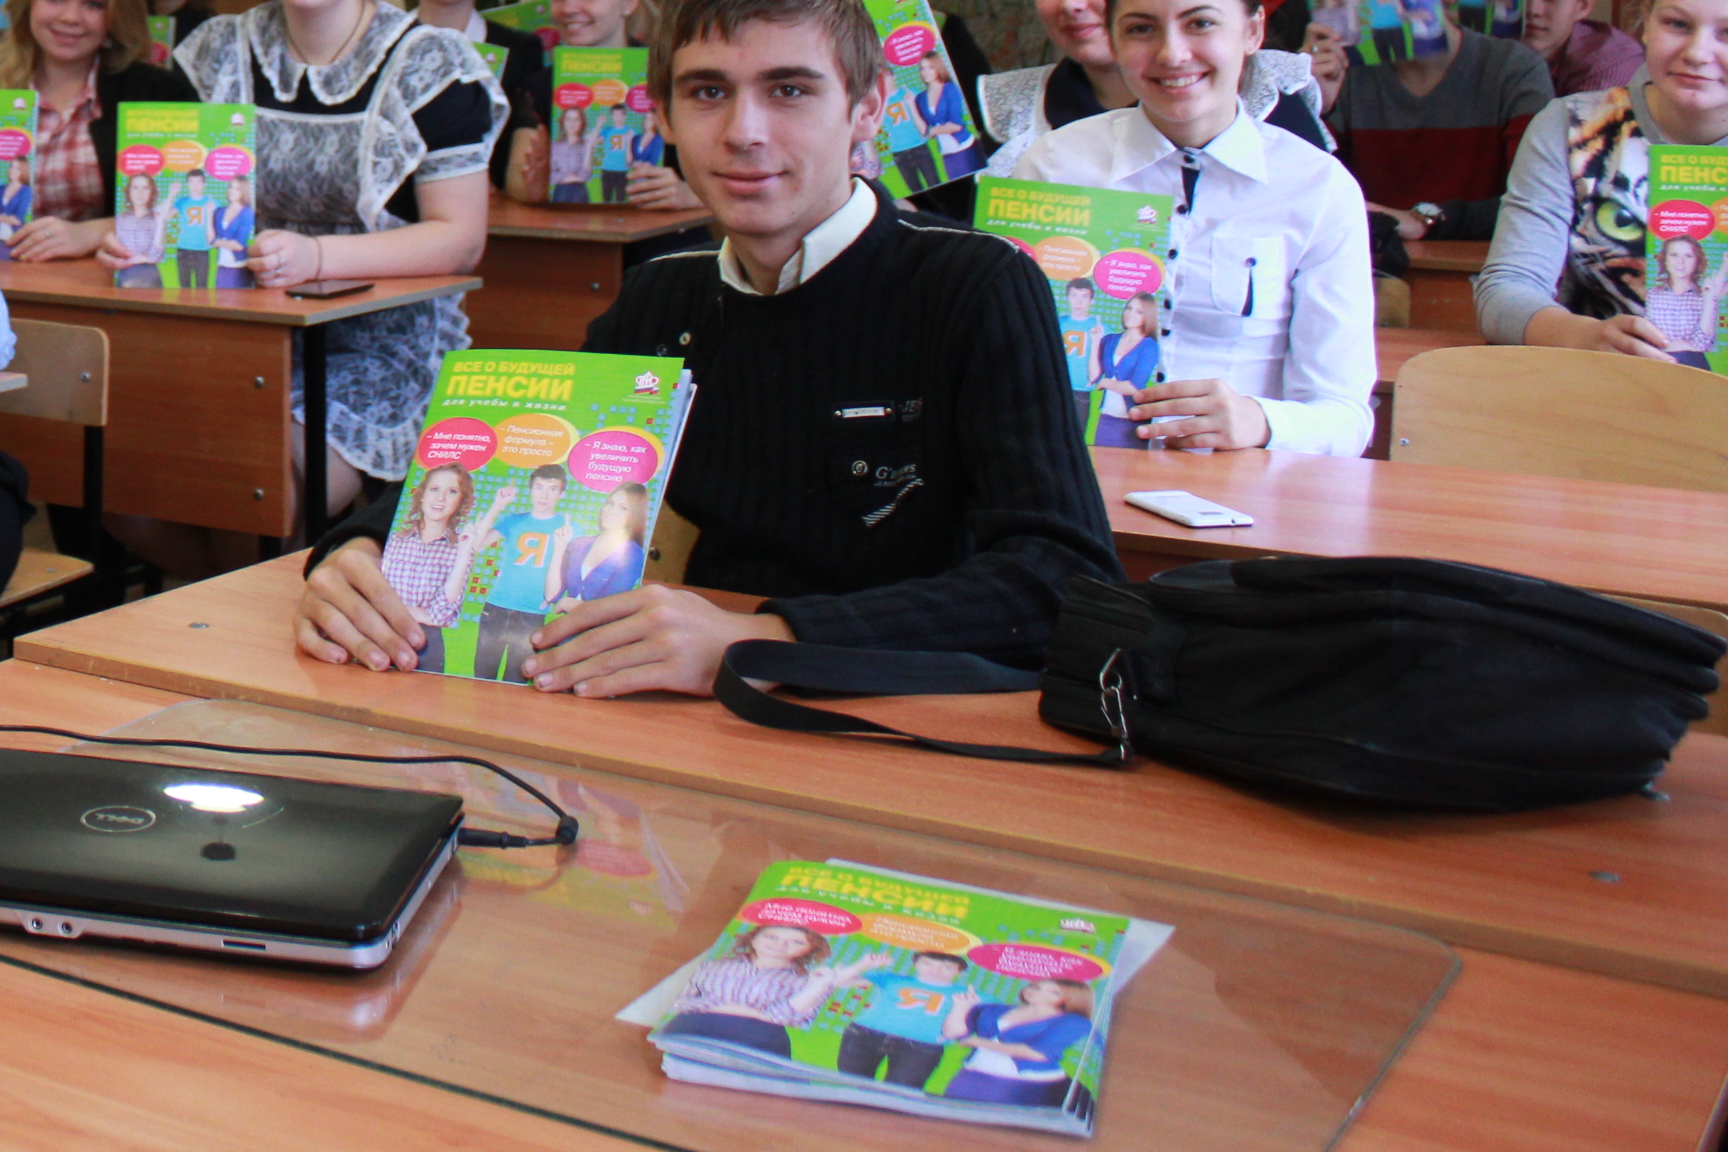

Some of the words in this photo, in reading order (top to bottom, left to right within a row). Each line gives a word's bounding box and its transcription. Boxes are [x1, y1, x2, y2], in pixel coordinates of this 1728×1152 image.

[1660, 154, 1686, 164] ВСЕ
[1688, 154, 1698, 164] О
[1660, 165, 1728, 184] ПЕНС
[990, 187, 1016, 199] ВСЕ
[1016, 189, 1027, 200] О
[1029, 190, 1092, 206] БУДУЩЕЙ
[987, 199, 1092, 227] ПЕНСИИ
[1063, 330, 1087, 358] Я
[453, 361, 483, 373] ВСЕ
[485, 361, 497, 373] О
[499, 361, 576, 376] БУДУЩЕЙ
[446, 375, 574, 401] ПЕНСИИ
[442, 399, 466, 407] для
[468, 398, 508, 407] учебы
[512, 400, 520, 408] и
[524, 402, 567, 411] жизни
[433, 432, 452, 440] Мне
[453, 434, 491, 443] понятно,
[507, 425, 564, 437] Пенсионная
[429, 442, 458, 450] зачем
[458, 443, 487, 452] нужен
[504, 435, 547, 446] формула
[519, 447, 553, 457] просто
[593, 441, 601, 449] Я
[602, 443, 628, 453] знаю,
[630, 446, 648, 454] как
[427, 451, 462, 460] СНИЛС
[589, 453, 639, 464] увеличить
[588, 461, 632, 473] будущую
[585, 472, 623, 483] пенсию
[515, 532, 550, 568] Я
[95, 813, 145, 825] DELL
[789, 867, 833, 879] ВСЕ
[837, 871, 854, 882] О
[858, 876, 970, 906] БУДУЩЕЙ
[780, 873, 969, 920] ПЕНСИИ
[895, 987, 944, 1016] Я
